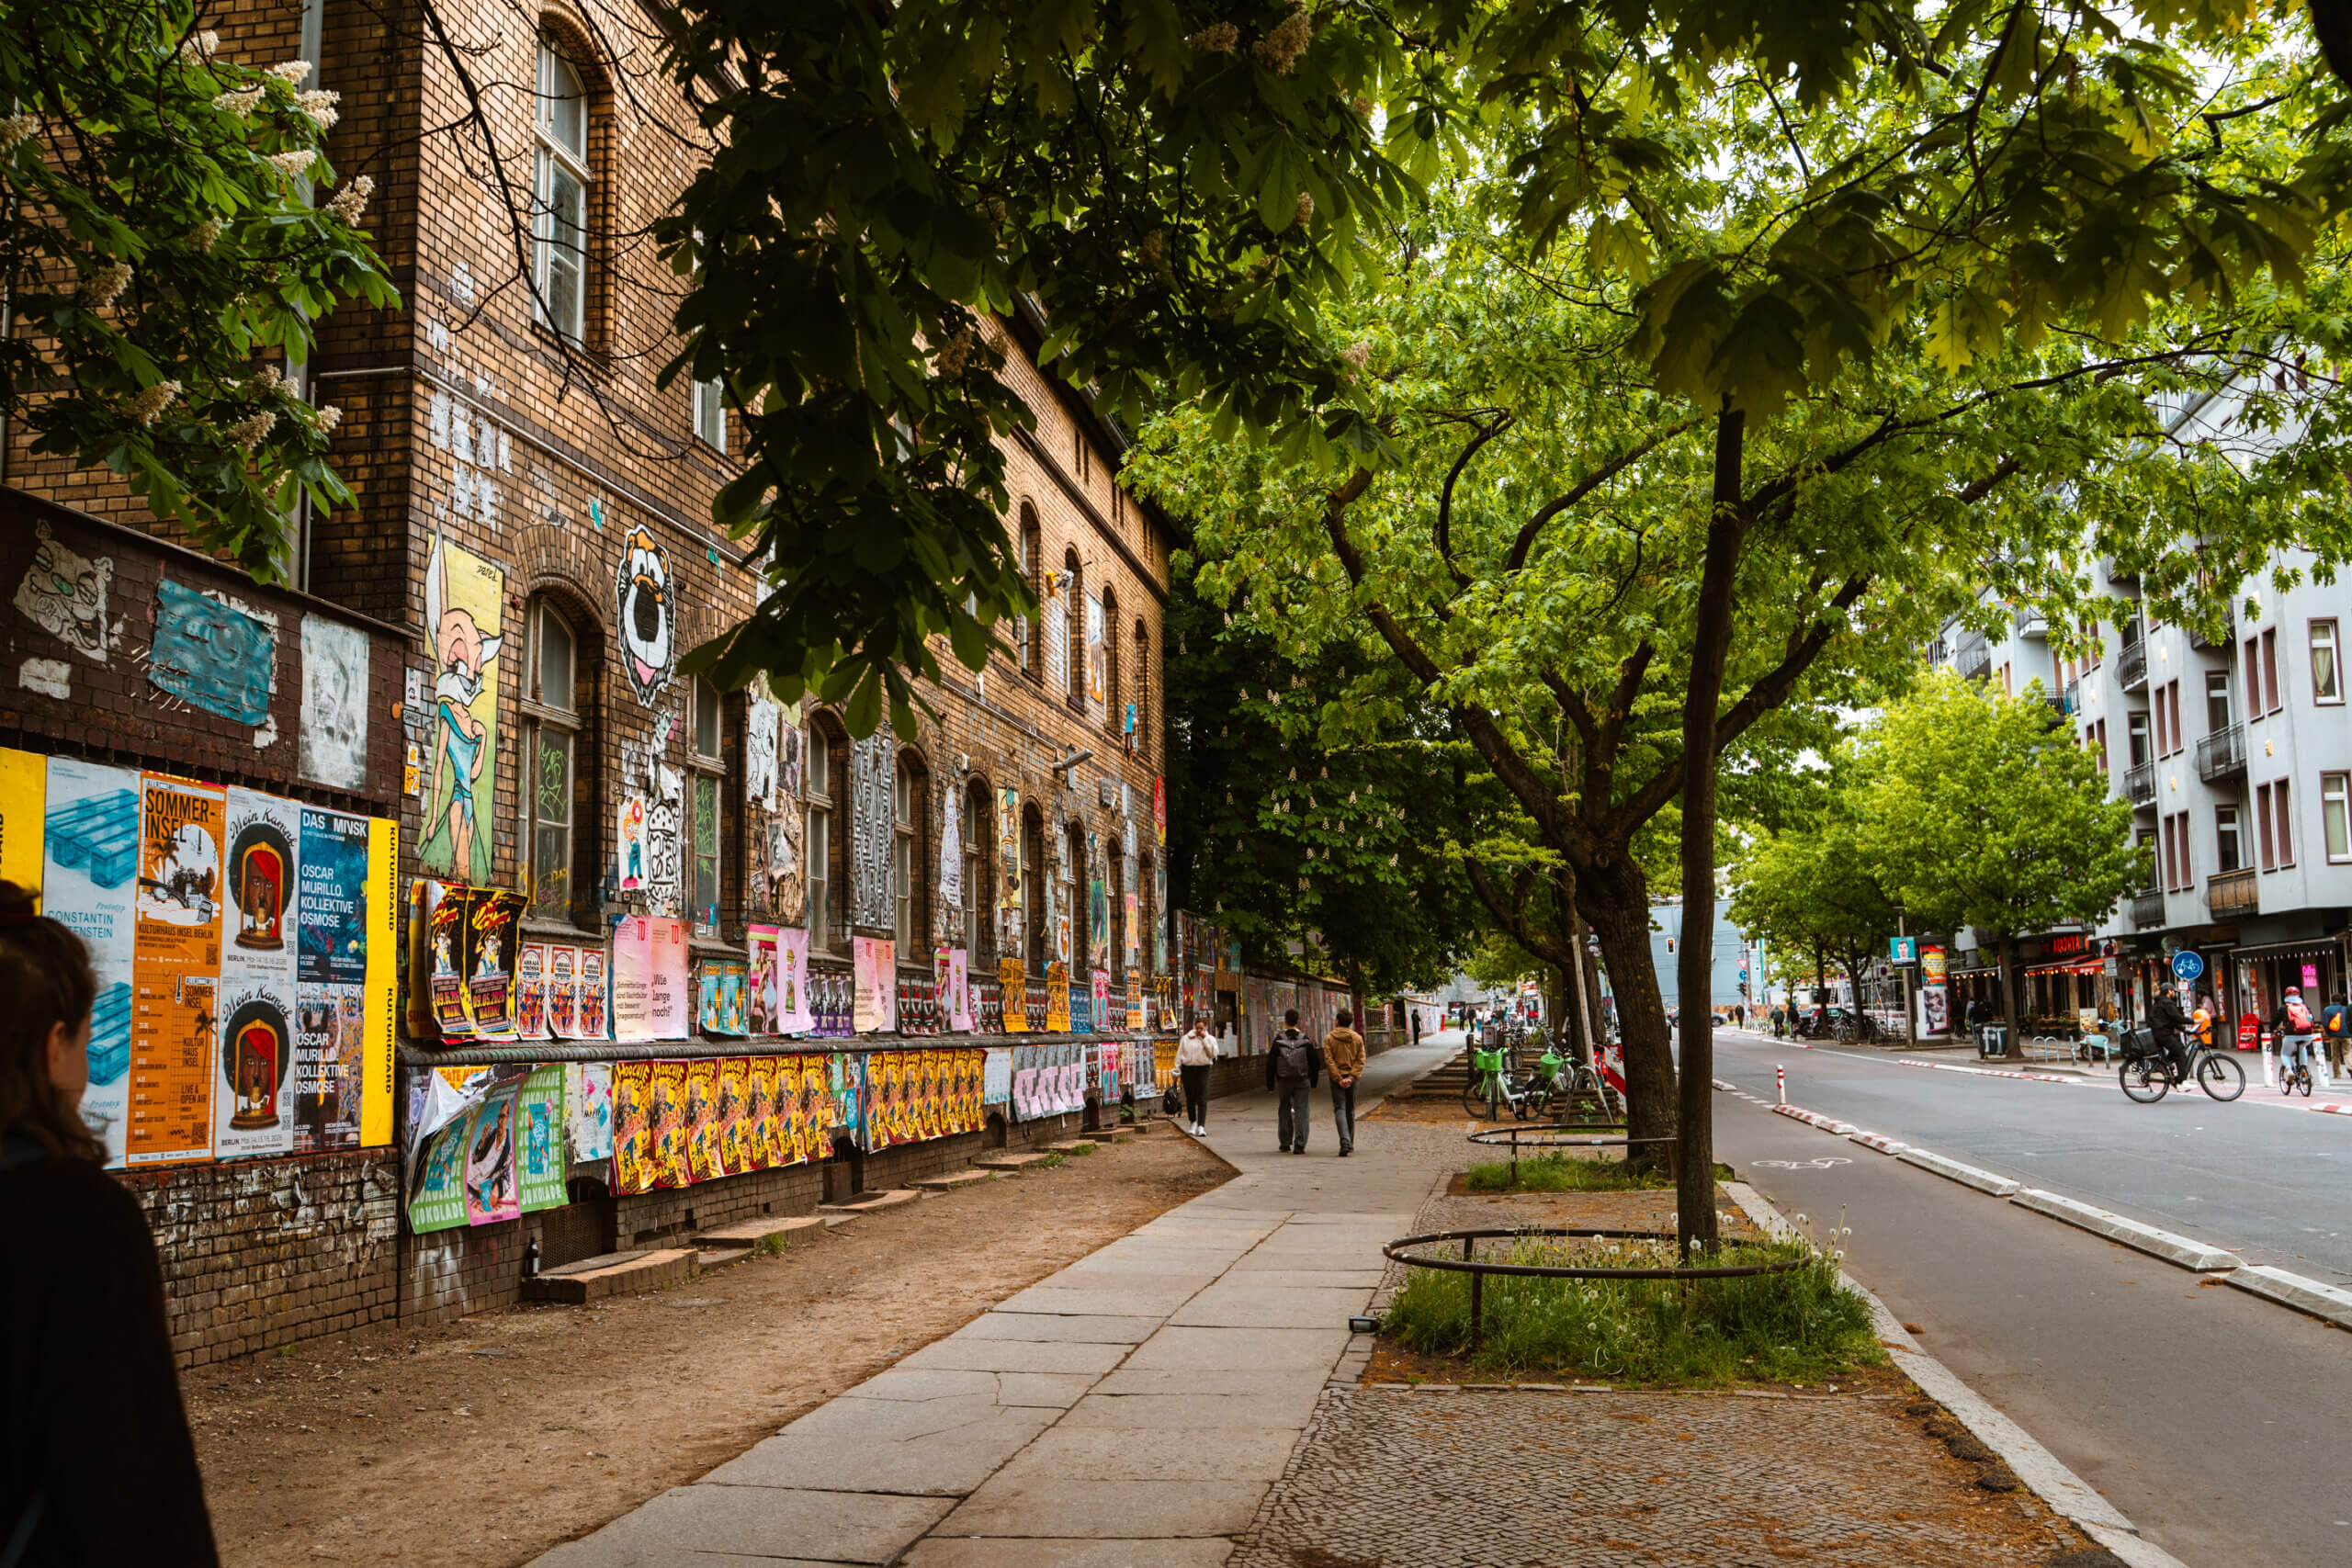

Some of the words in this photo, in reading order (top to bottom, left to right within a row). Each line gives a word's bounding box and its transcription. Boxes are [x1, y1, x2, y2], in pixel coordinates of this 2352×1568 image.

[145, 789, 215, 823] SOMMER-
[145, 814, 187, 843] INSEL
[302, 812, 325, 830] DAS
[333, 818, 368, 838] MINSK
[301, 864, 334, 880] OSCAR
[301, 880, 344, 897] MURILLO.
[301, 896, 354, 914] KOLLEKTIVE
[48, 910, 114, 925] CONSTANTIN
[300, 912, 340, 928] OSMOSE
[138, 924, 176, 936] KULTURHAUS
[176, 926, 193, 938] INSEL
[195, 928, 213, 939] BERLIN
[185, 998, 202, 1009] INSEL
[296, 1032, 329, 1046] OSCAR
[386, 987, 394, 1094] KULTURBOARD
[296, 1049, 338, 1062] MURILLO.
[296, 1064, 349, 1078] KOLLEKTIVE
[295, 1080, 334, 1094] OSMOSE
[522, 1183, 562, 1205] JOKOLADE
[415, 1201, 465, 1225] JOKOLADE
